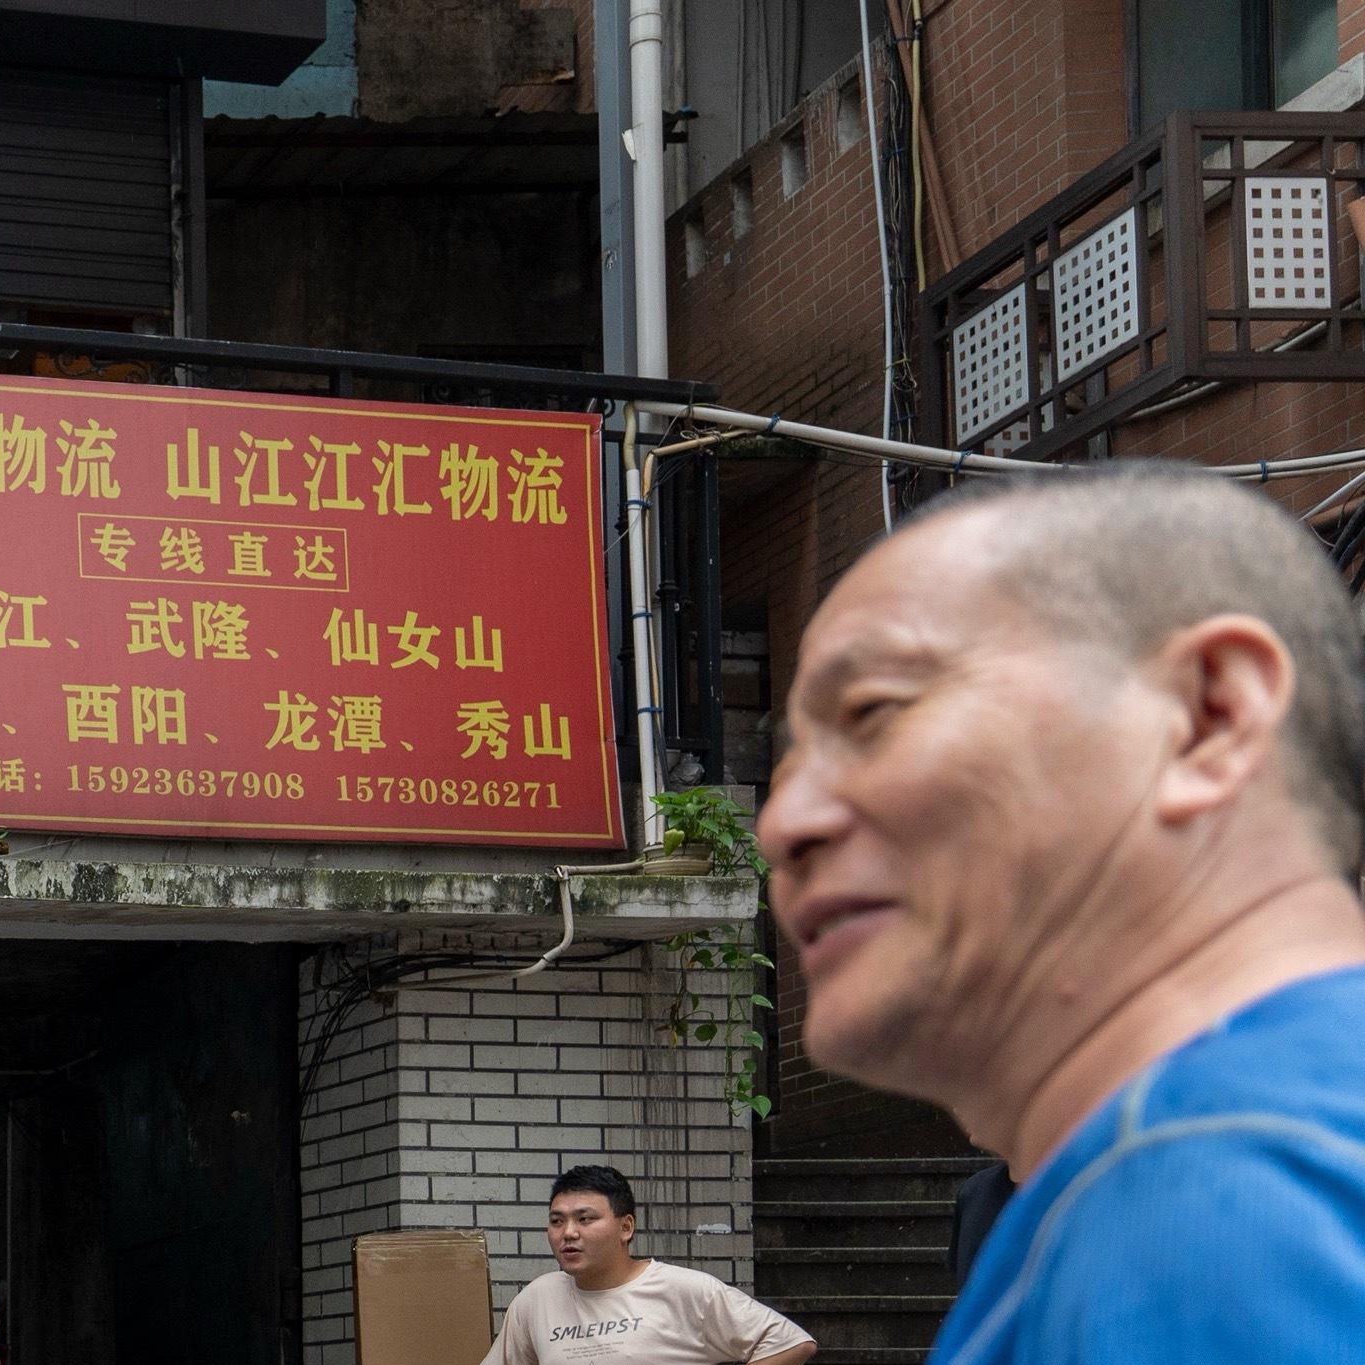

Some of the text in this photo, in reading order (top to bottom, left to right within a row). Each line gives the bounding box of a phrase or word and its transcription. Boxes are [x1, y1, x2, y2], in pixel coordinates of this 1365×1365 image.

[166, 428, 568, 525] 山江江汇物流
[90, 523, 338, 581] 专线直达
[339, 776, 557, 808] 15730826271
[549, 1317, 643, 1342] SMLEIPST
